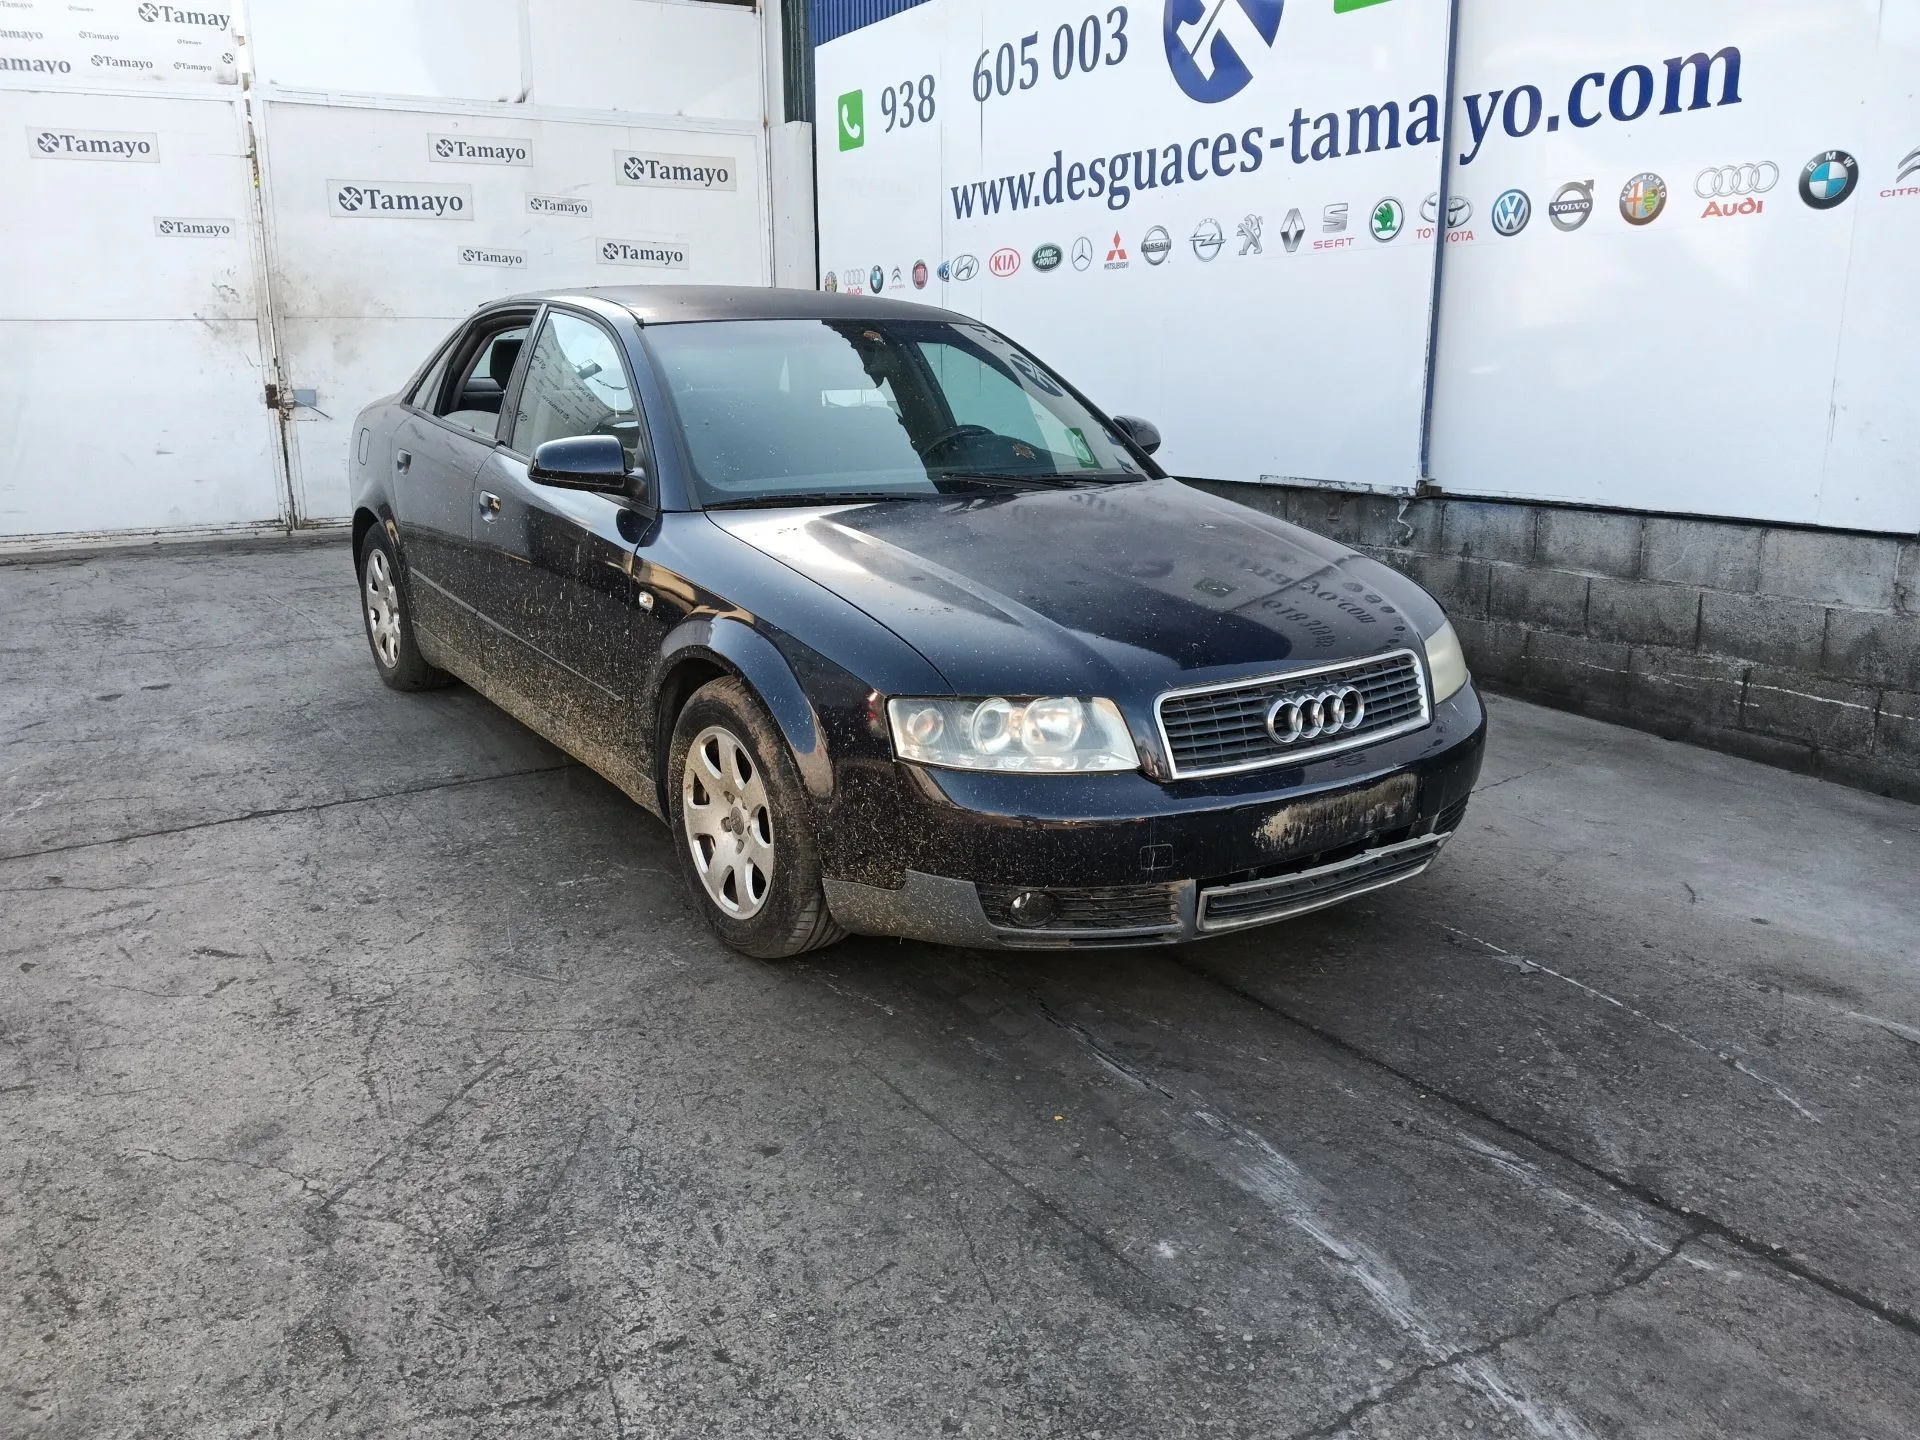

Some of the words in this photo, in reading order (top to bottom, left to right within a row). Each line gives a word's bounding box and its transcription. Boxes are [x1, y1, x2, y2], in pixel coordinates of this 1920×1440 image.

[159, 5, 231, 31] Tamay
[0, 29, 43, 42] amayo
[0, 57, 71, 74] amayo
[103, 56, 153, 70] Tamayo
[180, 62, 212, 72] Tamayo
[881, 74, 936, 133] 938
[972, 31, 1039, 102] 605
[1052, 5, 1128, 80] 003
[951, 46, 1742, 220] www.desguaces-tamayo.com
[60, 135, 151, 158] Tamayo
[454, 141, 527, 161] Tamayo
[645, 159, 729, 186] Tamayo
[1880, 187, 1920, 198] CITR
[364, 188, 464, 217] Tamayo
[543, 199, 588, 214] Tamayo
[1552, 202, 1589, 212] VOLVO
[174, 221, 230, 237] Tamayo
[1143, 241, 1169, 250] NISSAN
[1313, 237, 1355, 250] SEAT
[475, 250, 522, 266] Tamayo
[620, 244, 684, 263] Tamayo
[1037, 249, 1052, 258] LAND
[1038, 256, 1058, 266] ROVER
[994, 254, 1015, 271] KIA
